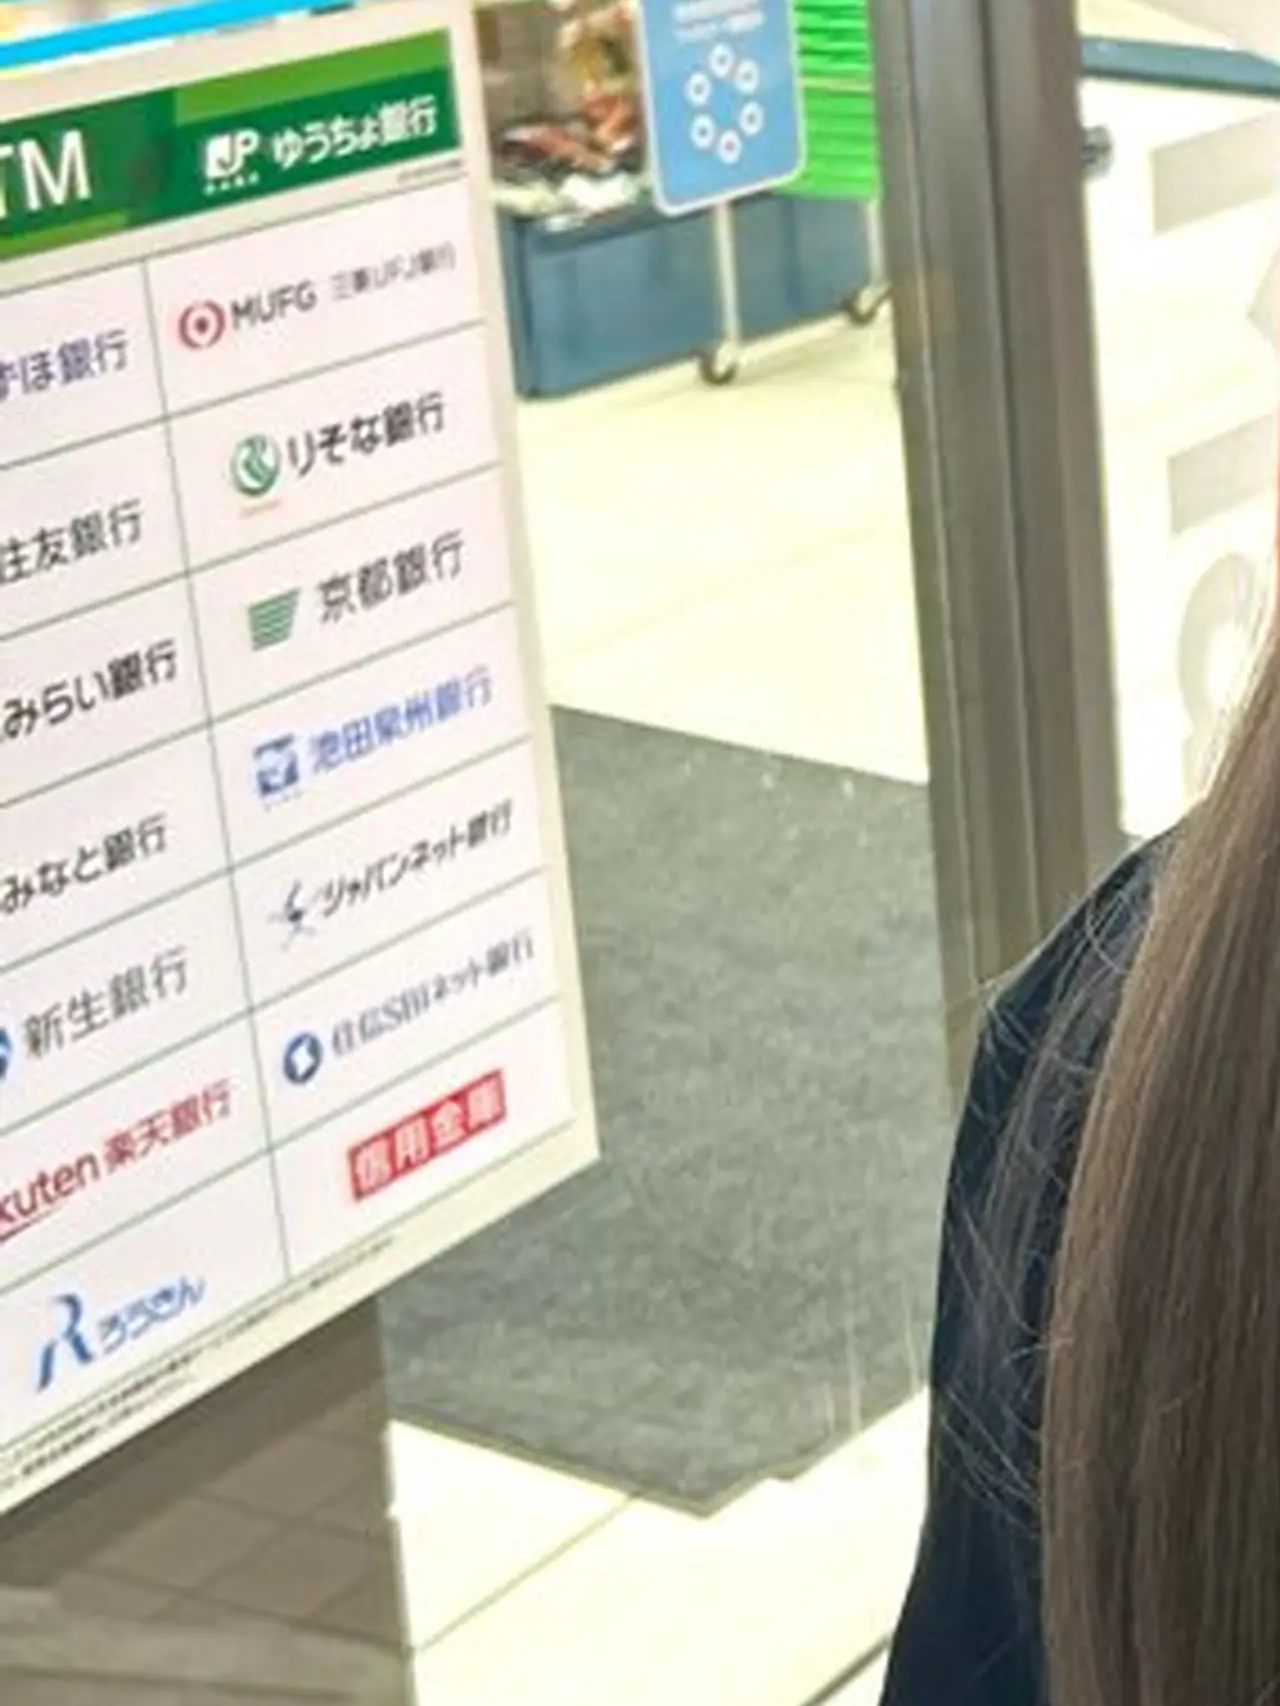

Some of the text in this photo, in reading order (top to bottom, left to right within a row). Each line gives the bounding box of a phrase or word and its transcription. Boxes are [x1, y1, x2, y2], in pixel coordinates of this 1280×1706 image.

[271, 94, 438, 171] ゆうちょ銀行
[230, 282, 318, 330] MUFG
[289, 391, 446, 477] りそな銀行
[316, 529, 465, 624] 京都銀行
[3, 638, 177, 740] みらい銀行
[0, 811, 168, 915] みなと銀行
[23, 945, 188, 1060] 新生銀行
